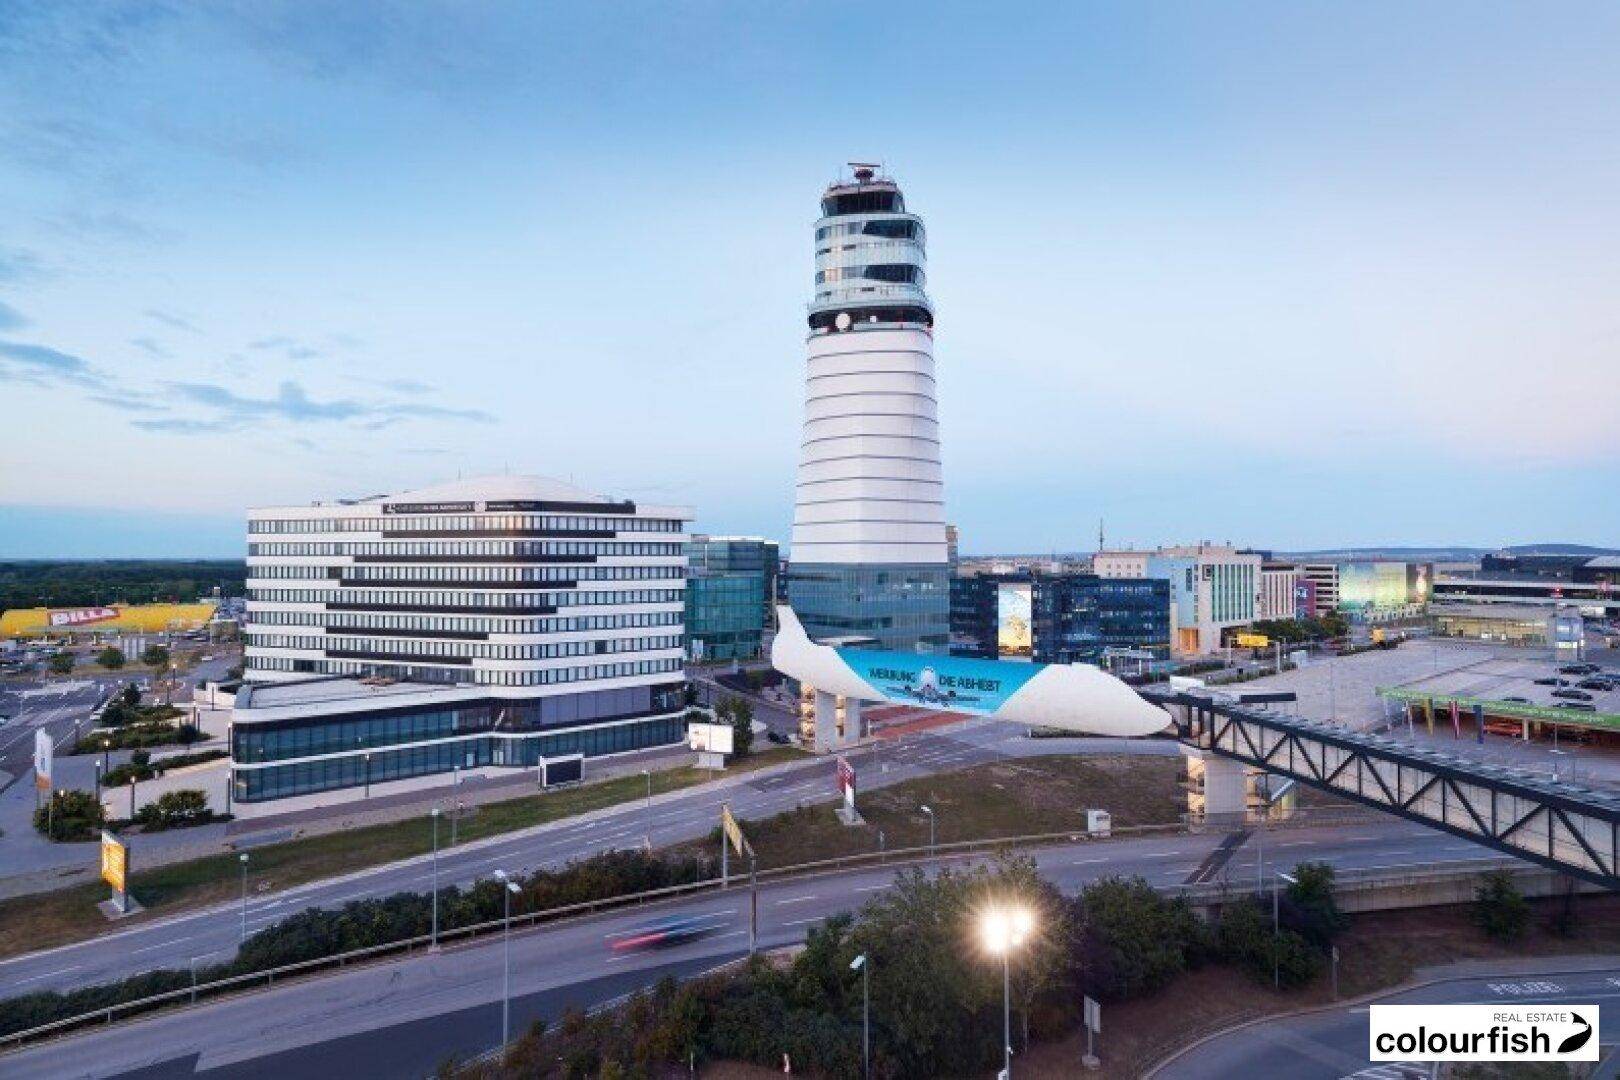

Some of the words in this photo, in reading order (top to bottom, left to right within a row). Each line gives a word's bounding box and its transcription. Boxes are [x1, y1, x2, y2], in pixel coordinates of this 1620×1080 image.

[52, 608, 117, 625] BILLA
[939, 674, 956, 688] DIE
[957, 678, 1001, 692] ABHEBT
